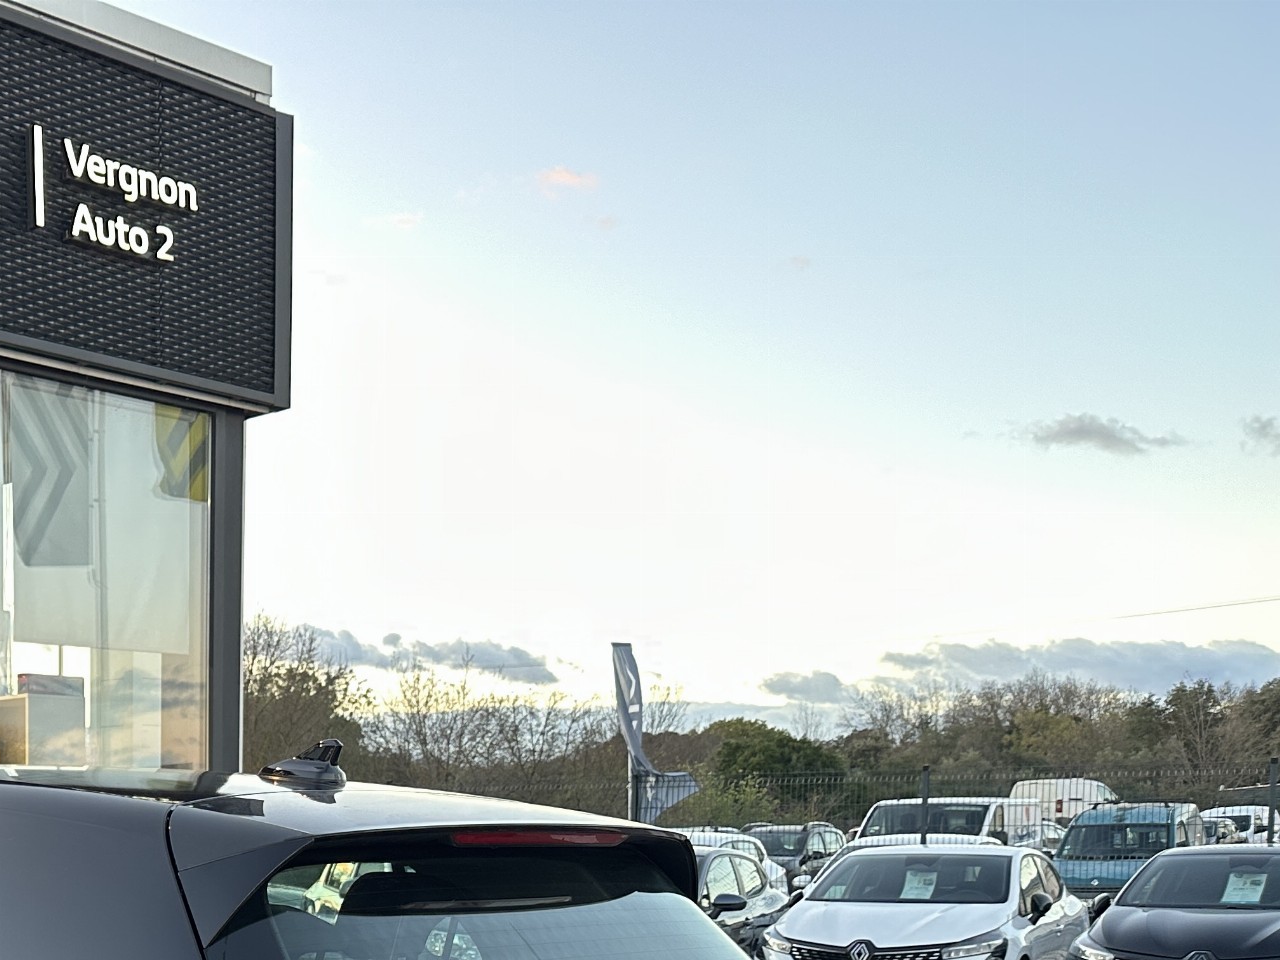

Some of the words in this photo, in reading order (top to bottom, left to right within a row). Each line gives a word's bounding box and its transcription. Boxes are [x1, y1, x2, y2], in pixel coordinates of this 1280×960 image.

[63, 138, 199, 211] Vergnon
[71, 203, 149, 255] Auto
[156, 225, 176, 261] 2
